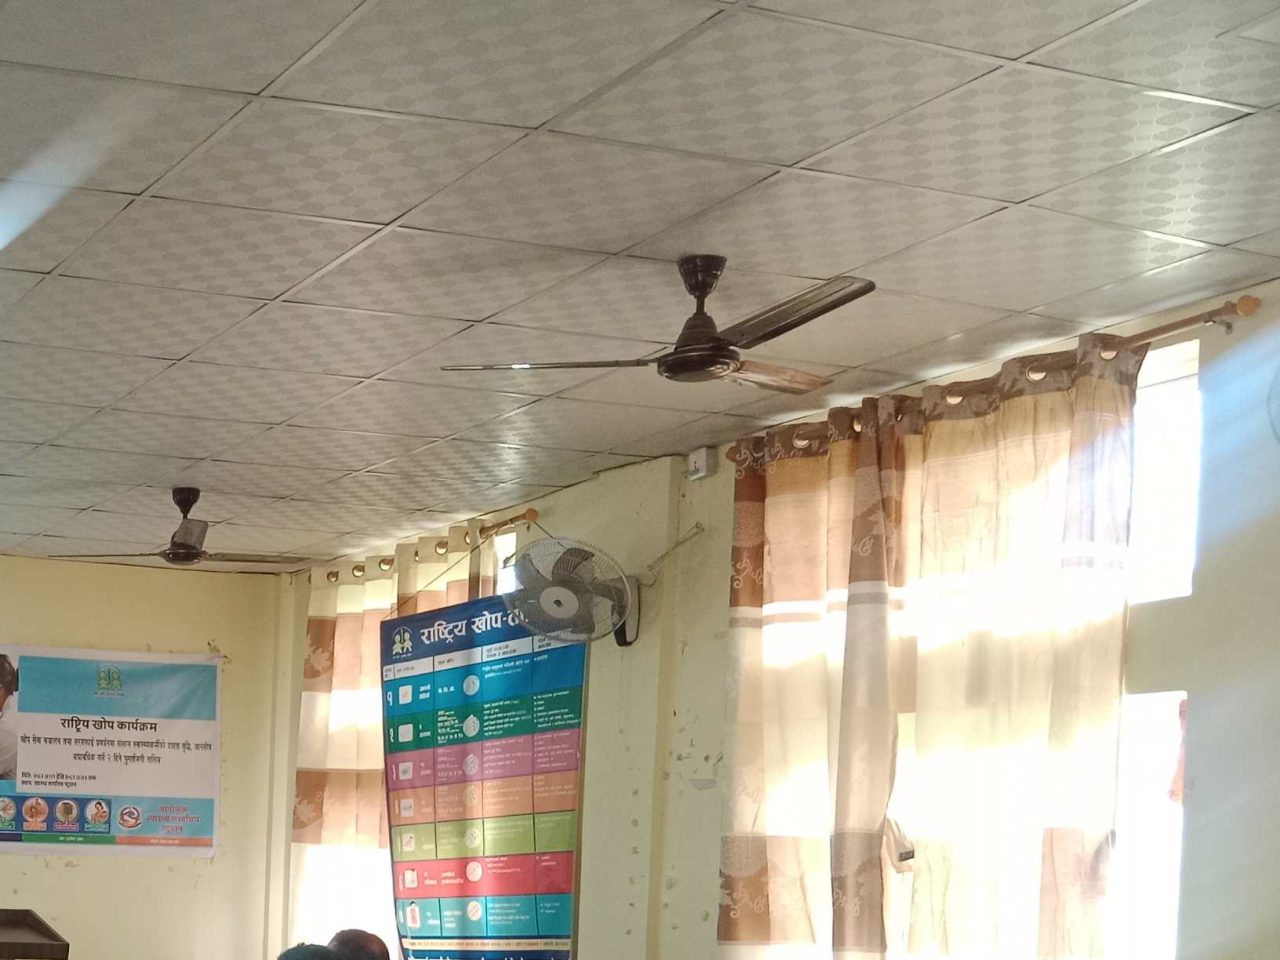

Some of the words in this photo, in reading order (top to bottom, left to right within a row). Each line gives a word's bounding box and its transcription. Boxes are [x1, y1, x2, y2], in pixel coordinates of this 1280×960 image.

[420, 619, 467, 645] राष्ट्रिय
[60, 716, 90, 733] राष्ट्रिय
[92, 716, 115, 730] खोप
[117, 719, 158, 733] कार्यक्रम
